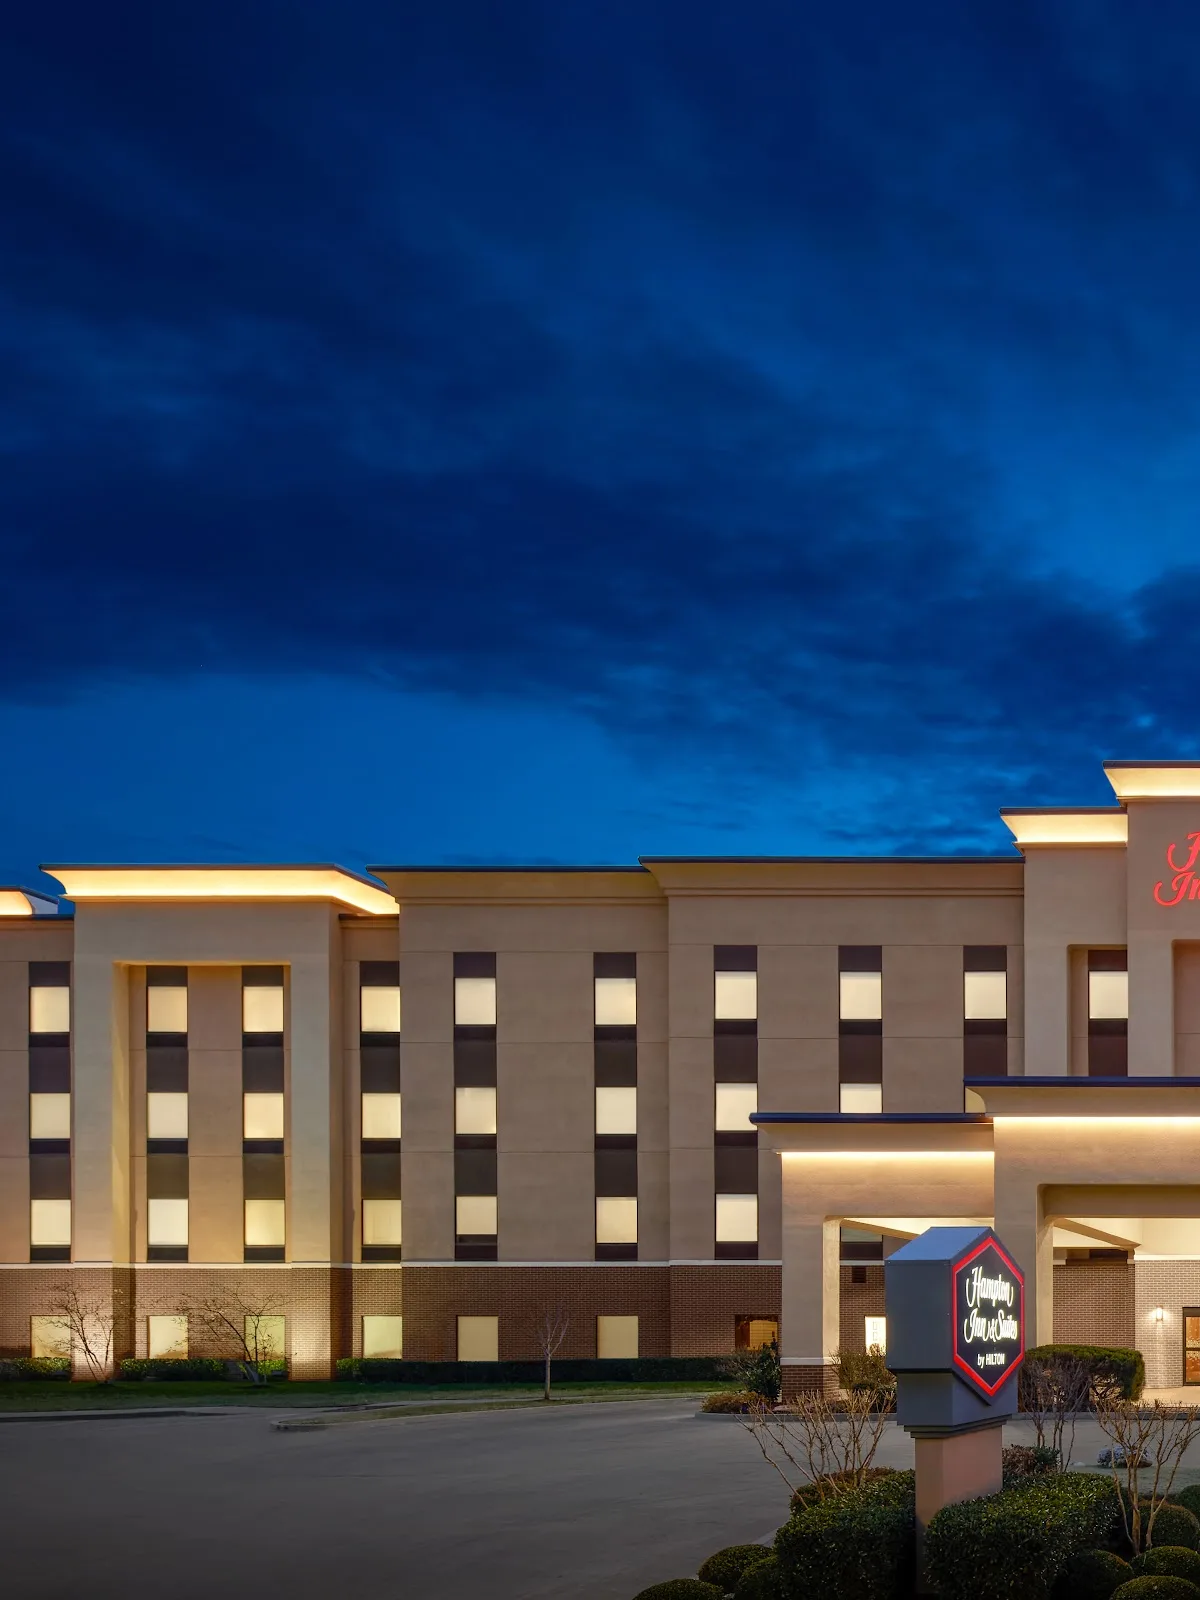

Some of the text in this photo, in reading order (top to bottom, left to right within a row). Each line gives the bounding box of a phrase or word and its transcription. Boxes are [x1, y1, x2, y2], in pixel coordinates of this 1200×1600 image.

[965, 1265, 1014, 1308] Hampton
[964, 1307, 1018, 1343] Inn & Suites
[977, 1352, 1005, 1369] by HILTON
